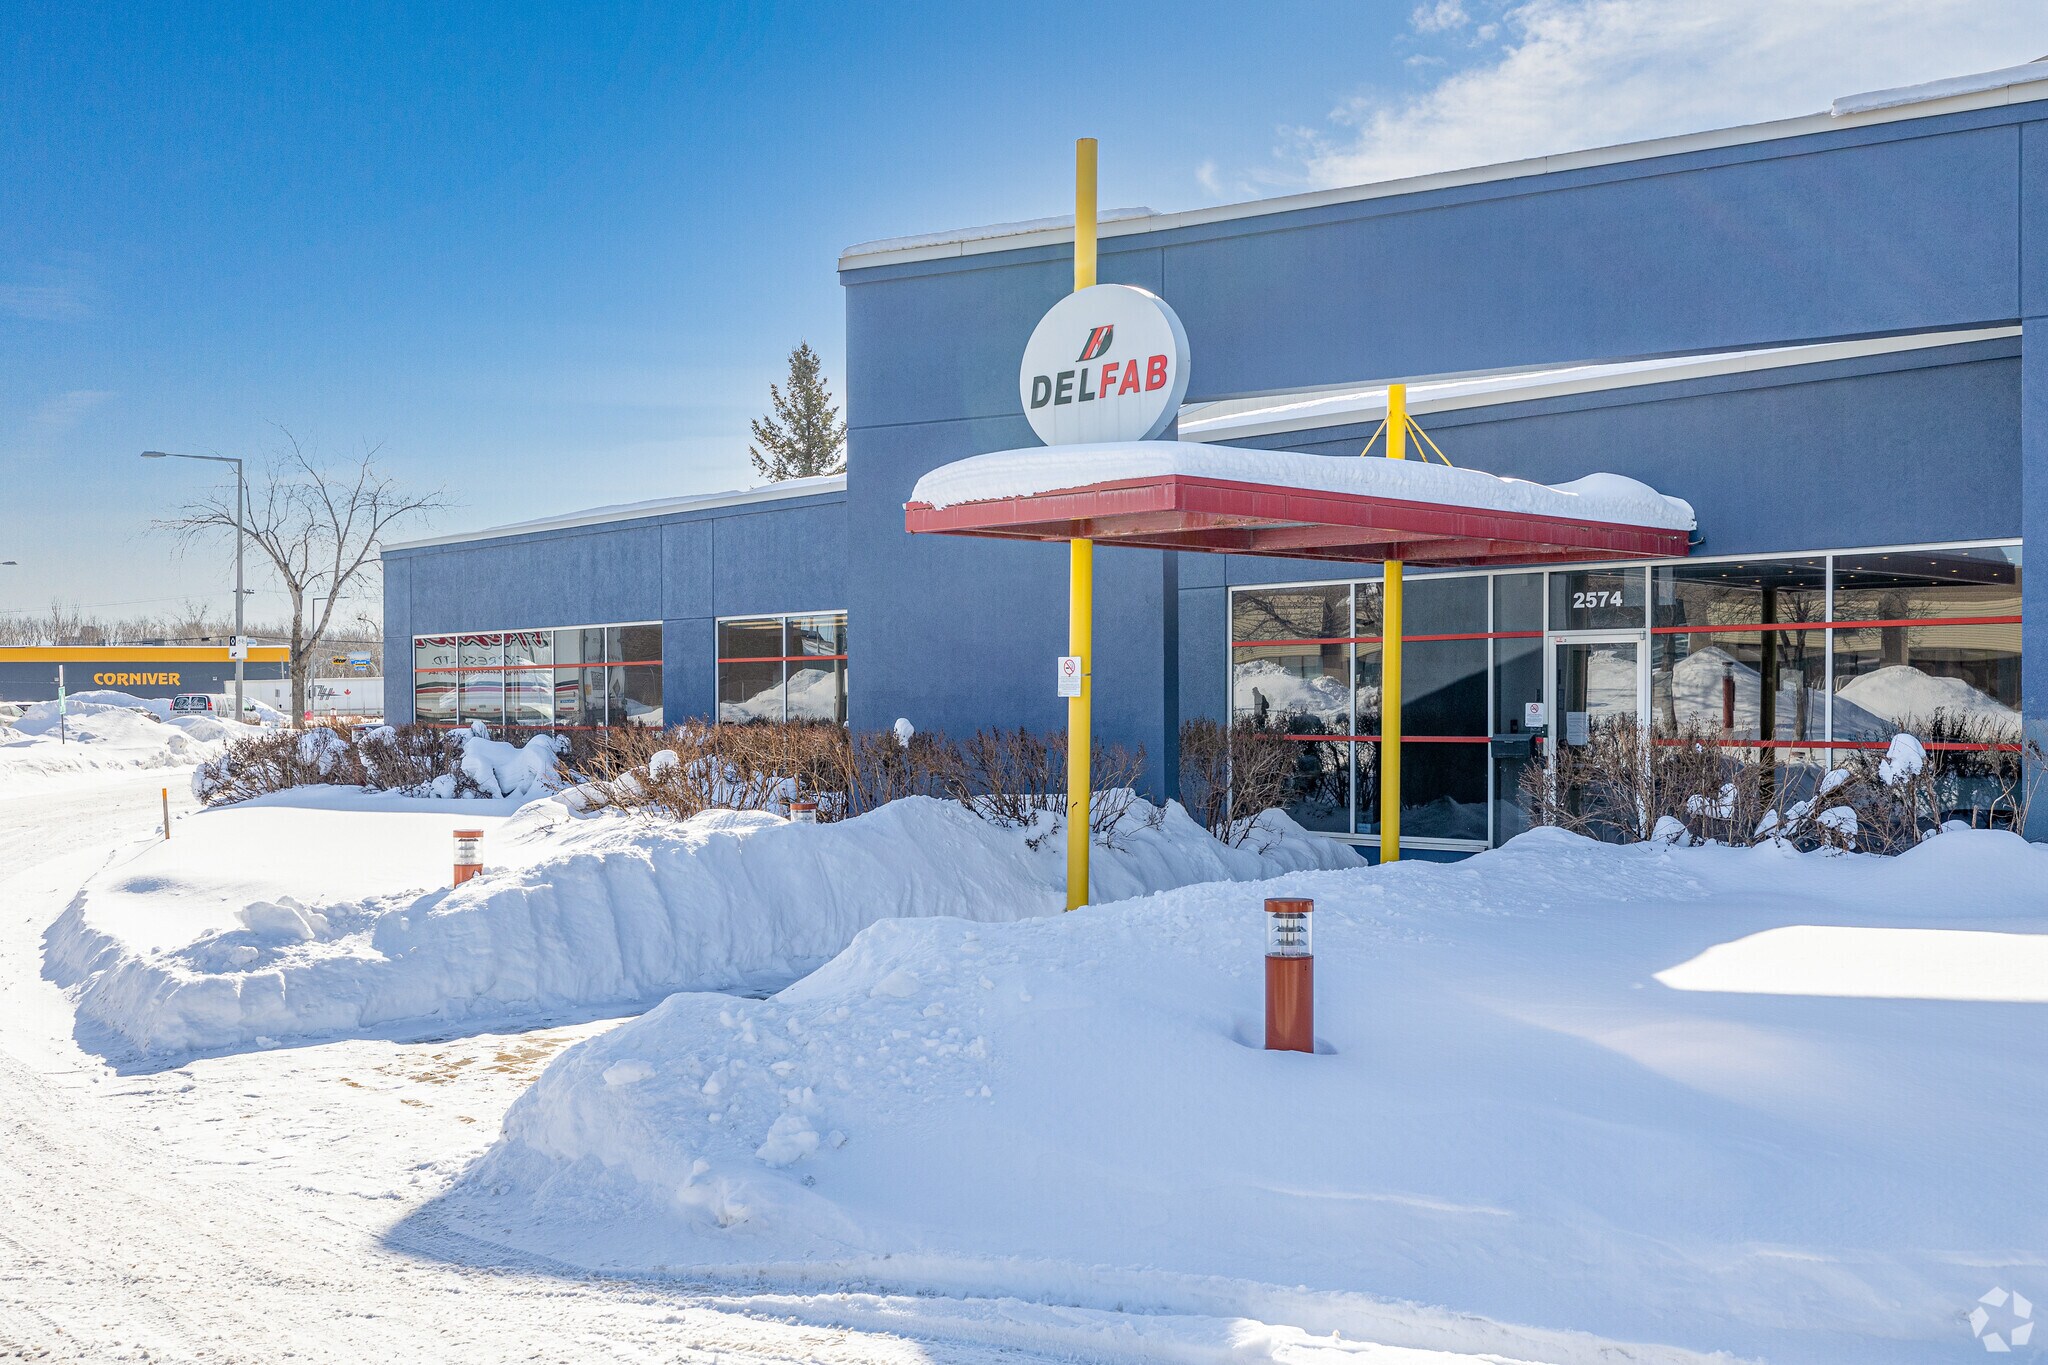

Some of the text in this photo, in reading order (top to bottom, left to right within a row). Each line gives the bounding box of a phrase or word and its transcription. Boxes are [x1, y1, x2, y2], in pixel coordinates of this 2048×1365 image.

[1030, 354, 1168, 409] DELFAB
[1573, 590, 1623, 609] 2574
[93, 672, 181, 687] CORNIVER
